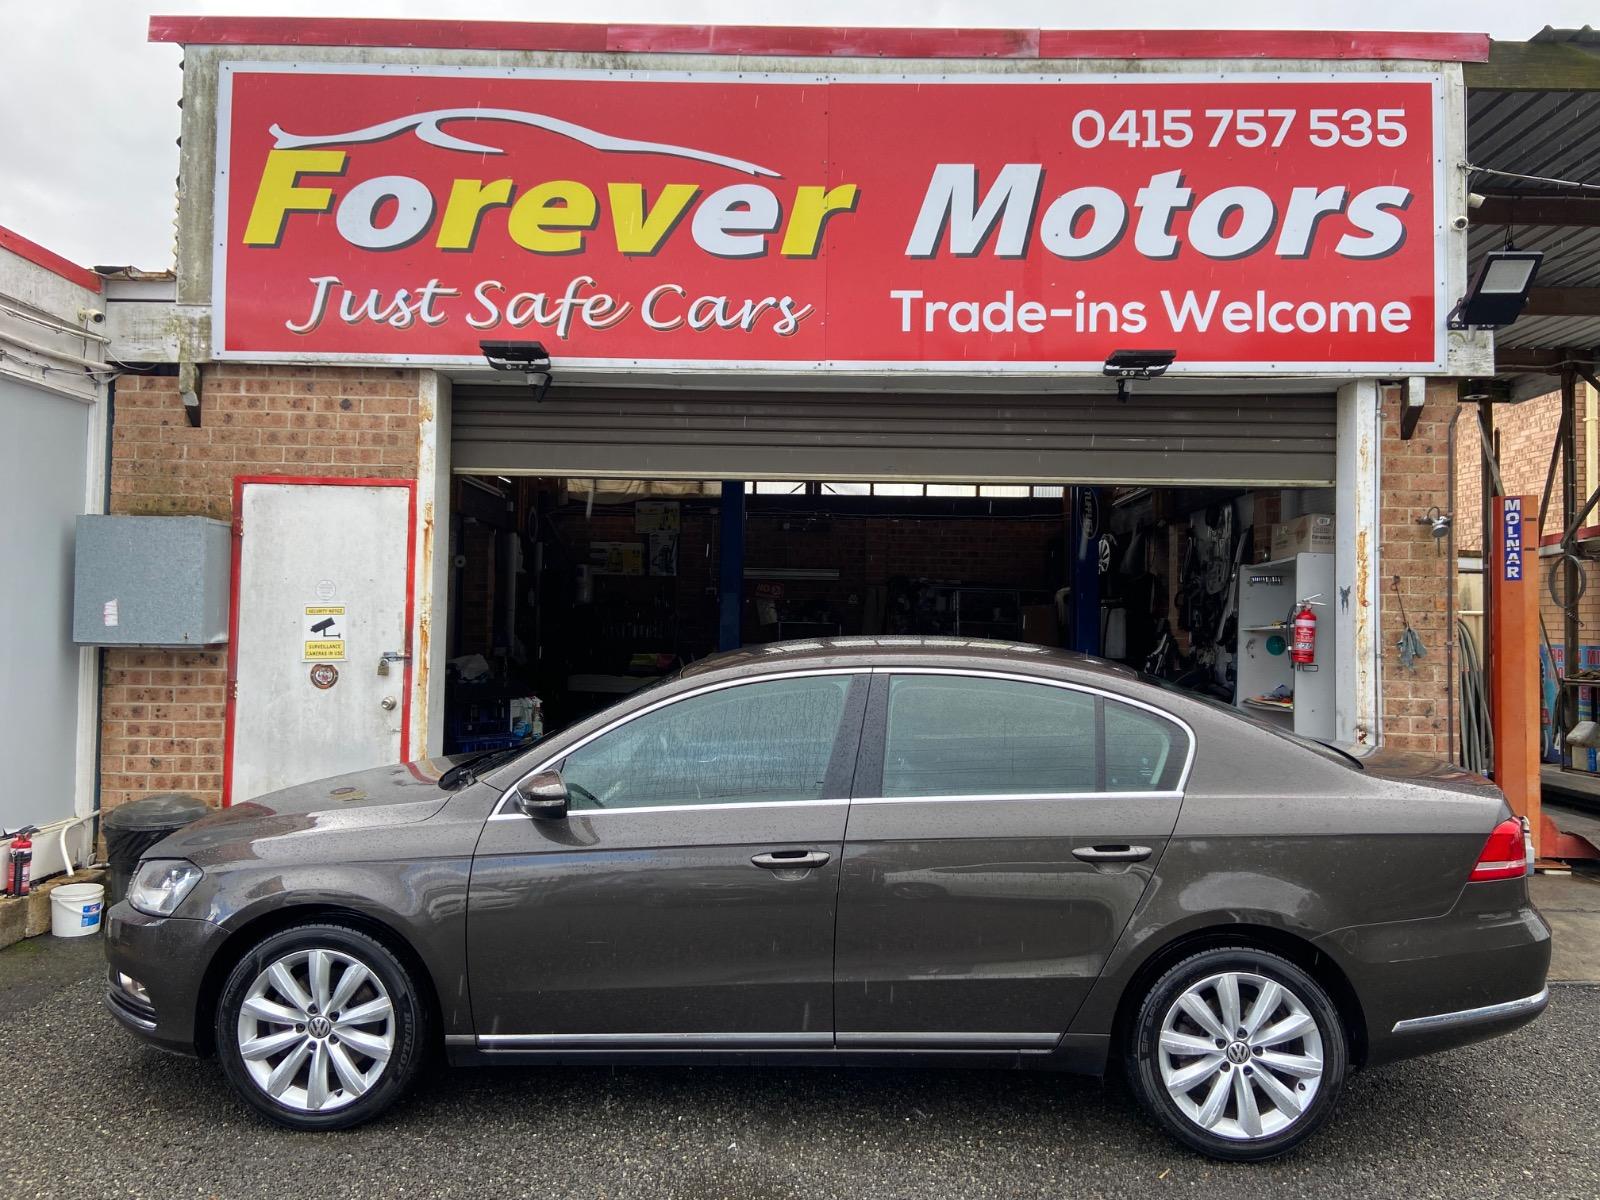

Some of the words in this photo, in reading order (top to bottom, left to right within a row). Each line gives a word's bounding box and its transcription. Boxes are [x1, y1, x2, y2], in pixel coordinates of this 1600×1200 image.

[1072, 109, 1194, 148] 0415
[1205, 109, 1297, 148] 757
[1309, 109, 1408, 148] 535
[242, 150, 859, 257] Forever
[905, 163, 1412, 259] Motors
[285, 276, 458, 333] Just
[465, 276, 632, 339] Safe
[641, 284, 813, 335] Cars
[890, 290, 1147, 333] Trade-ins
[1160, 290, 1412, 333] Welcome
[1504, 499, 1521, 578] MOLNAR
